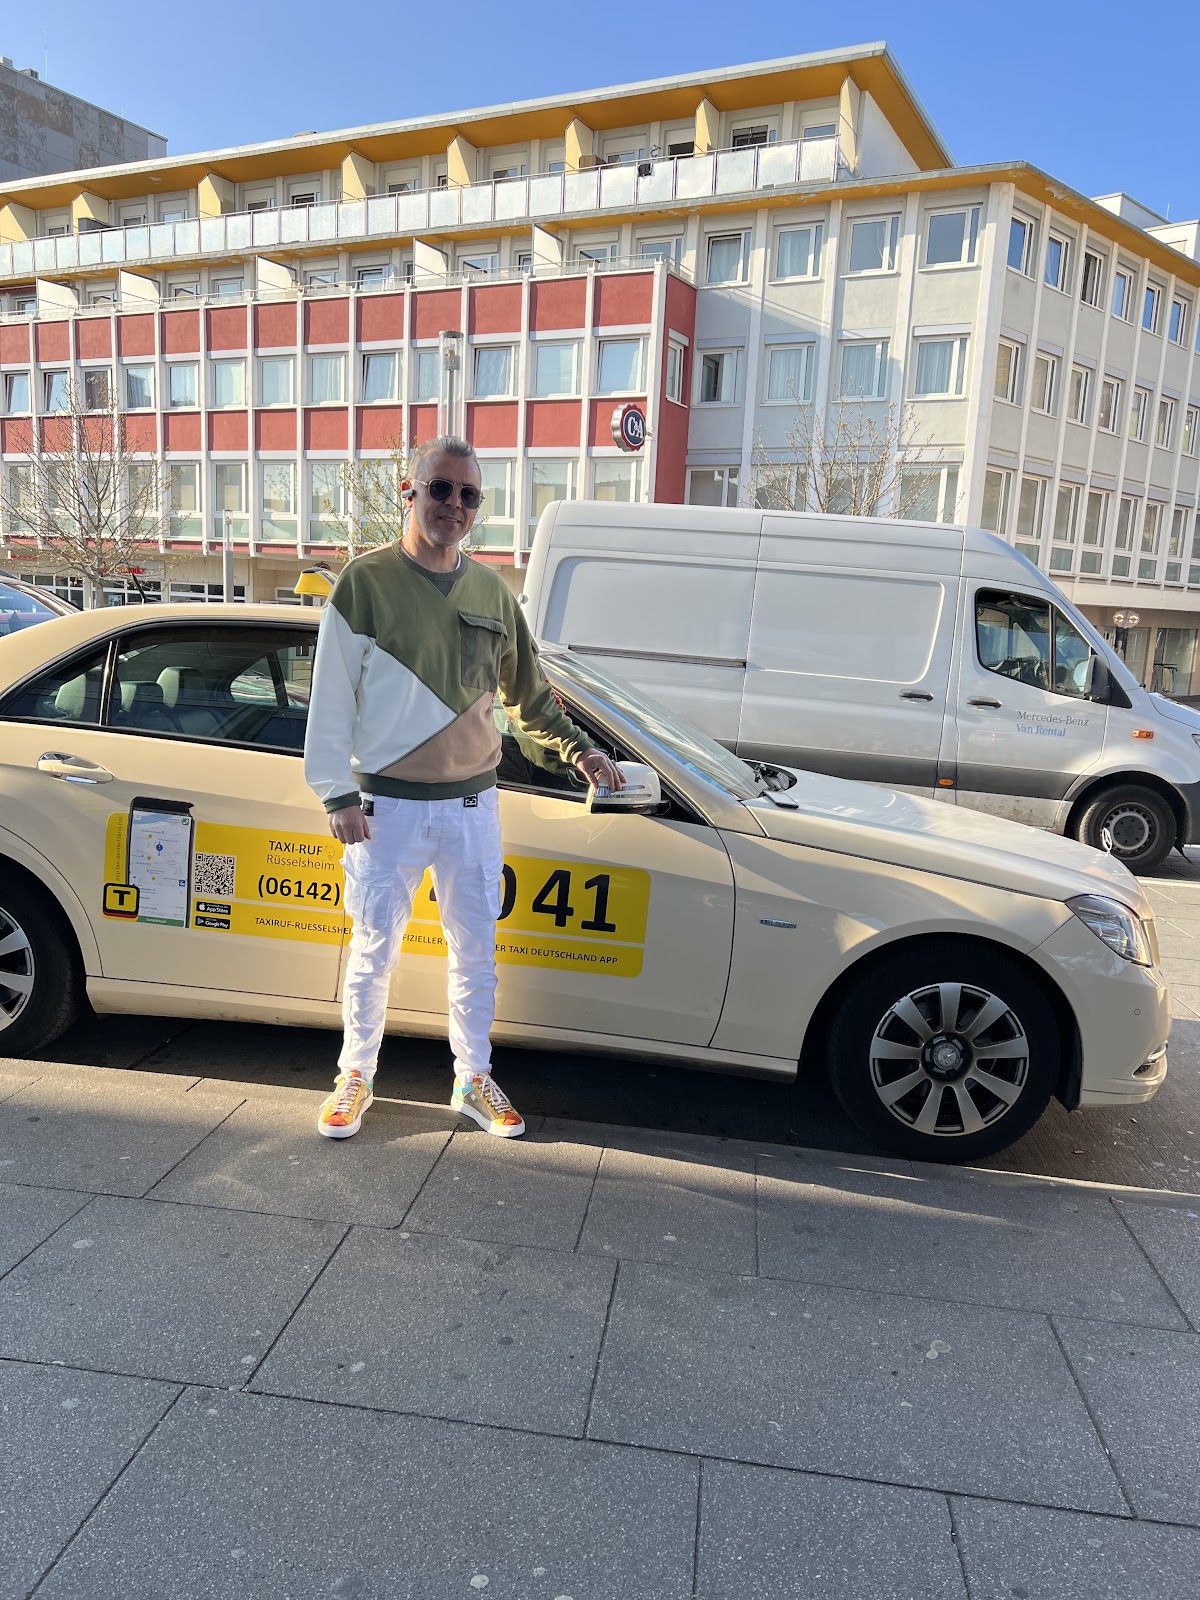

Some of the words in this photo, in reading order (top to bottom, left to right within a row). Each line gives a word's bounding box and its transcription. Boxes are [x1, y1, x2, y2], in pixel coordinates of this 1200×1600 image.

[628, 416, 644, 439] C&A
[1017, 711, 1090, 727] Mercedes-Benz
[1016, 723, 1033, 734] Van
[1036, 725, 1066, 737] Rental
[268, 840, 323, 856] TAXI-RUF
[266, 854, 335, 871] Rüsselsheim
[113, 889, 131, 905] T
[258, 874, 340, 906] (06142)
[532, 870, 616, 932] 41
[255, 917, 354, 936] TAXIRUF-RUESSELSHEI
[402, 934, 443, 945] FIZIELLER
[495, 944, 506, 952] ER
[509, 945, 528, 954] TAXI
[530, 948, 597, 962] DEUTSCHLAND
[600, 955, 618, 964] APP
